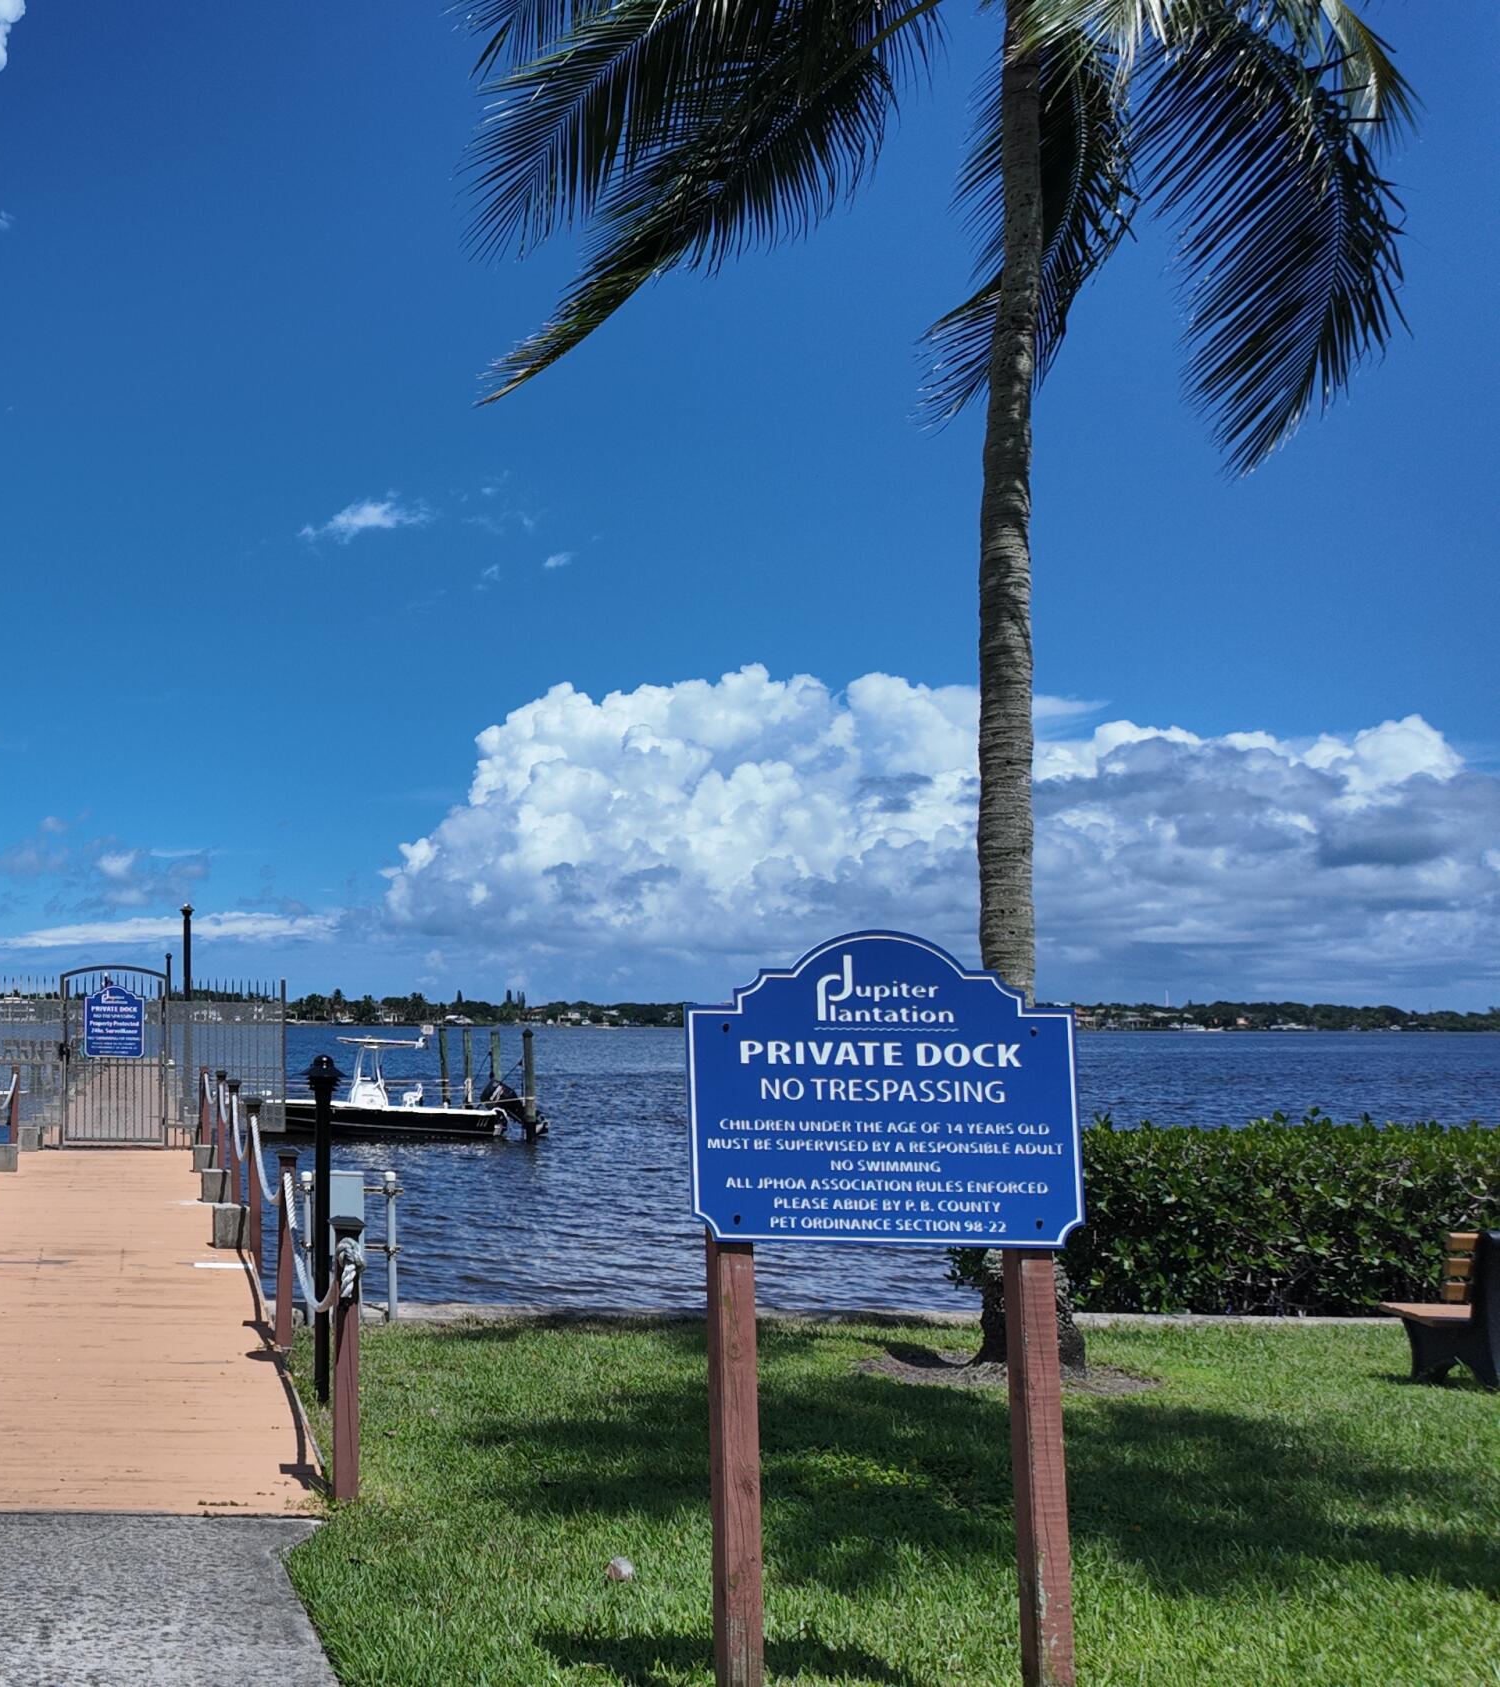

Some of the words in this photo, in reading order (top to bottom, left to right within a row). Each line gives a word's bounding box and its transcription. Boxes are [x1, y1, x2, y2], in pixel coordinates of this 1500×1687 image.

[828, 954, 940, 1001] Jupiter
[817, 972, 953, 1022] Plantation
[740, 1041, 903, 1065] PRIVATE
[917, 1043, 1021, 1067] DOCK
[761, 1078, 804, 1100] NO
[811, 1079, 1005, 1103] TRESPASSING
[720, 1119, 795, 1131] CHILDREN
[799, 1121, 851, 1132] UNDER
[855, 1121, 882, 1132] THE
[888, 1122, 916, 1133] AGE
[921, 1122, 940, 1133] OF
[947, 1124, 963, 1133] 14
[968, 1123, 1014, 1134] YEARS
[1018, 1124, 1049, 1134] OLD
[708, 1138, 749, 1149] MUST
[754, 1139, 771, 1150] BE
[776, 1139, 868, 1151] SUPERVISED
[872, 1141, 890, 1152] BY
[895, 1142, 905, 1152] A
[910, 1142, 1010, 1154] RESPONSIBLE
[1015, 1143, 1063, 1154] ADULT
[831, 1160, 853, 1170] NO
[858, 1160, 941, 1172] SWIMMING
[726, 1177, 752, 1188] ALL
[757, 1178, 806, 1189] JPHOA
[811, 1179, 912, 1191] ASSOCIATION
[916, 1181, 963, 1192] RULES
[968, 1181, 1048, 1193] ENFORCED
[774, 1197, 828, 1209] PLEASE
[833, 1199, 877, 1210] ABIDE
[883, 1200, 900, 1211] BY
[906, 1200, 916, 1211] P.
[921, 1200, 934, 1211] B.
[938, 1200, 1000, 1212] COUNTY
[771, 1217, 796, 1228] PET
[801, 1217, 891, 1230] ORDINANCE
[896, 1219, 961, 1231] SECTION
[964, 1221, 1006, 1232] 98-22
